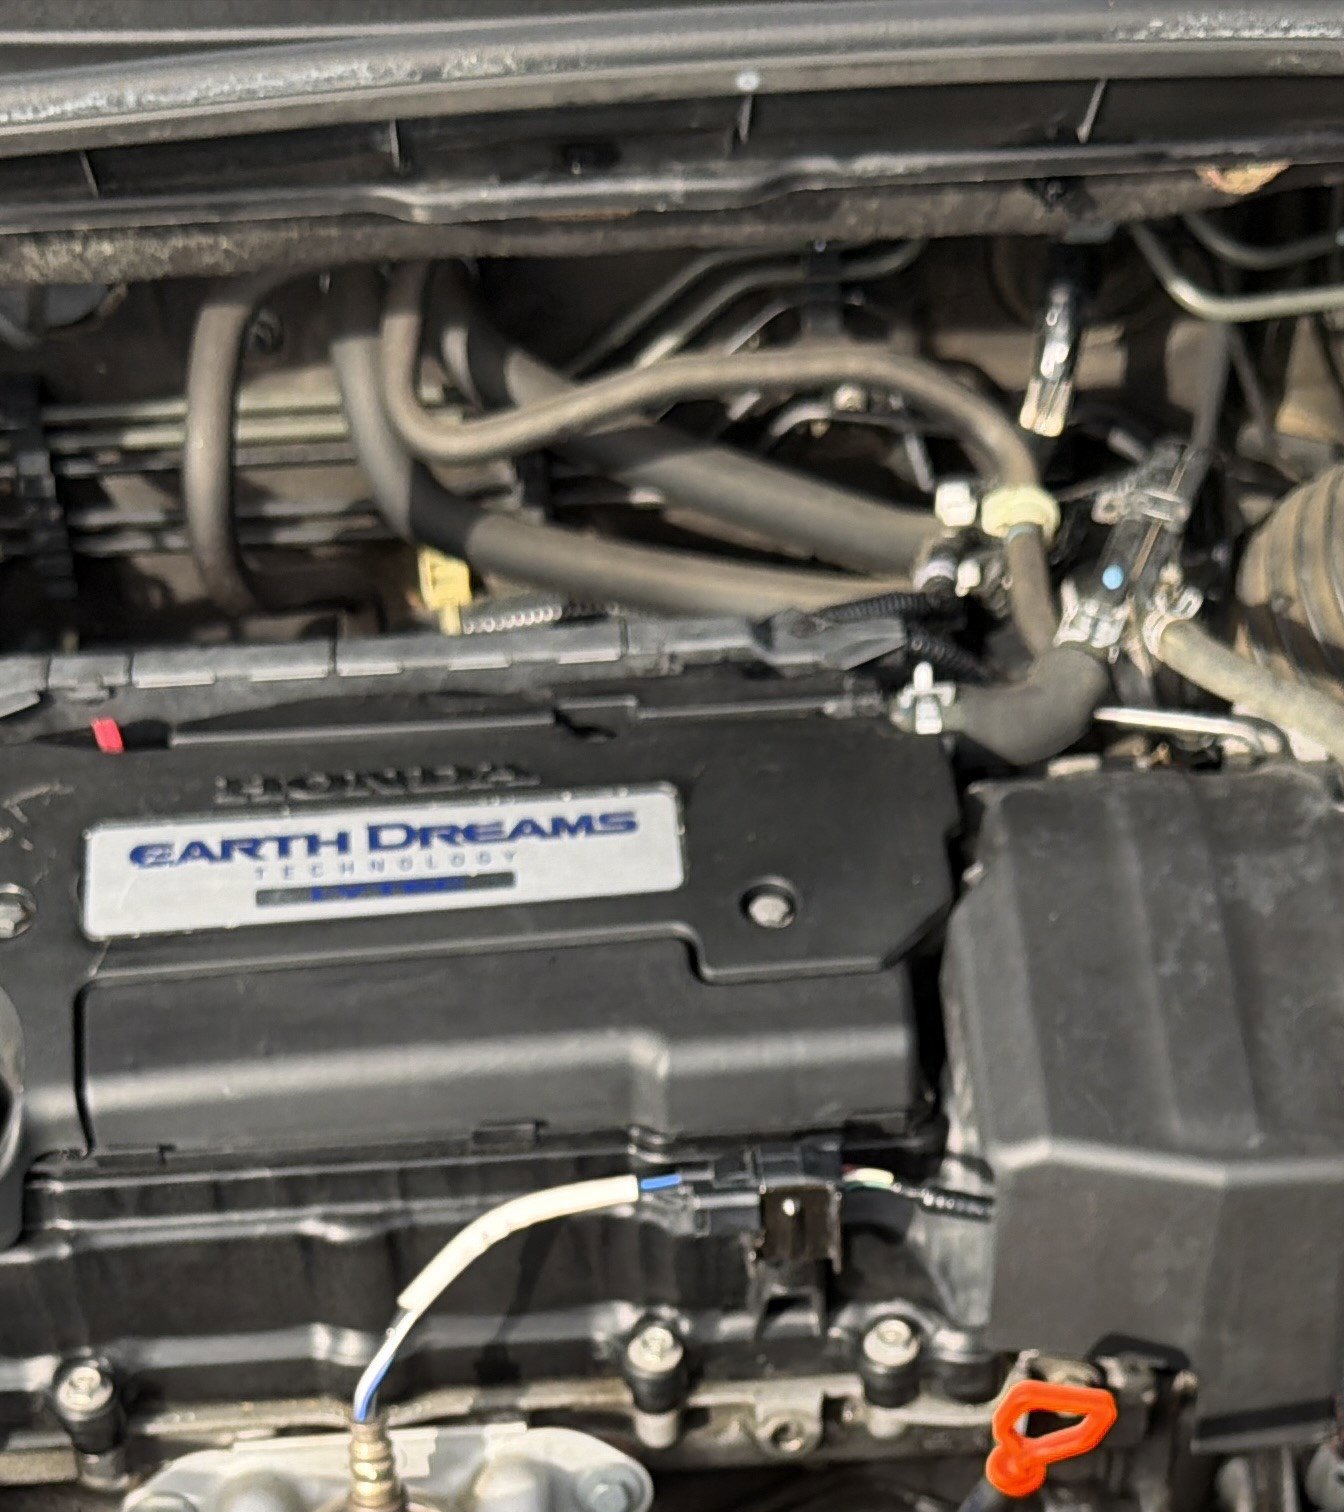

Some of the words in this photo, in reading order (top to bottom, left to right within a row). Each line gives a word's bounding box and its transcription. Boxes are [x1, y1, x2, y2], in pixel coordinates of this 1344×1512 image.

[215, 761, 541, 805] HONDA
[130, 822, 350, 868] EARTH
[367, 811, 639, 852] DREAMS
[255, 850, 518, 883] TECHNOLOGY
